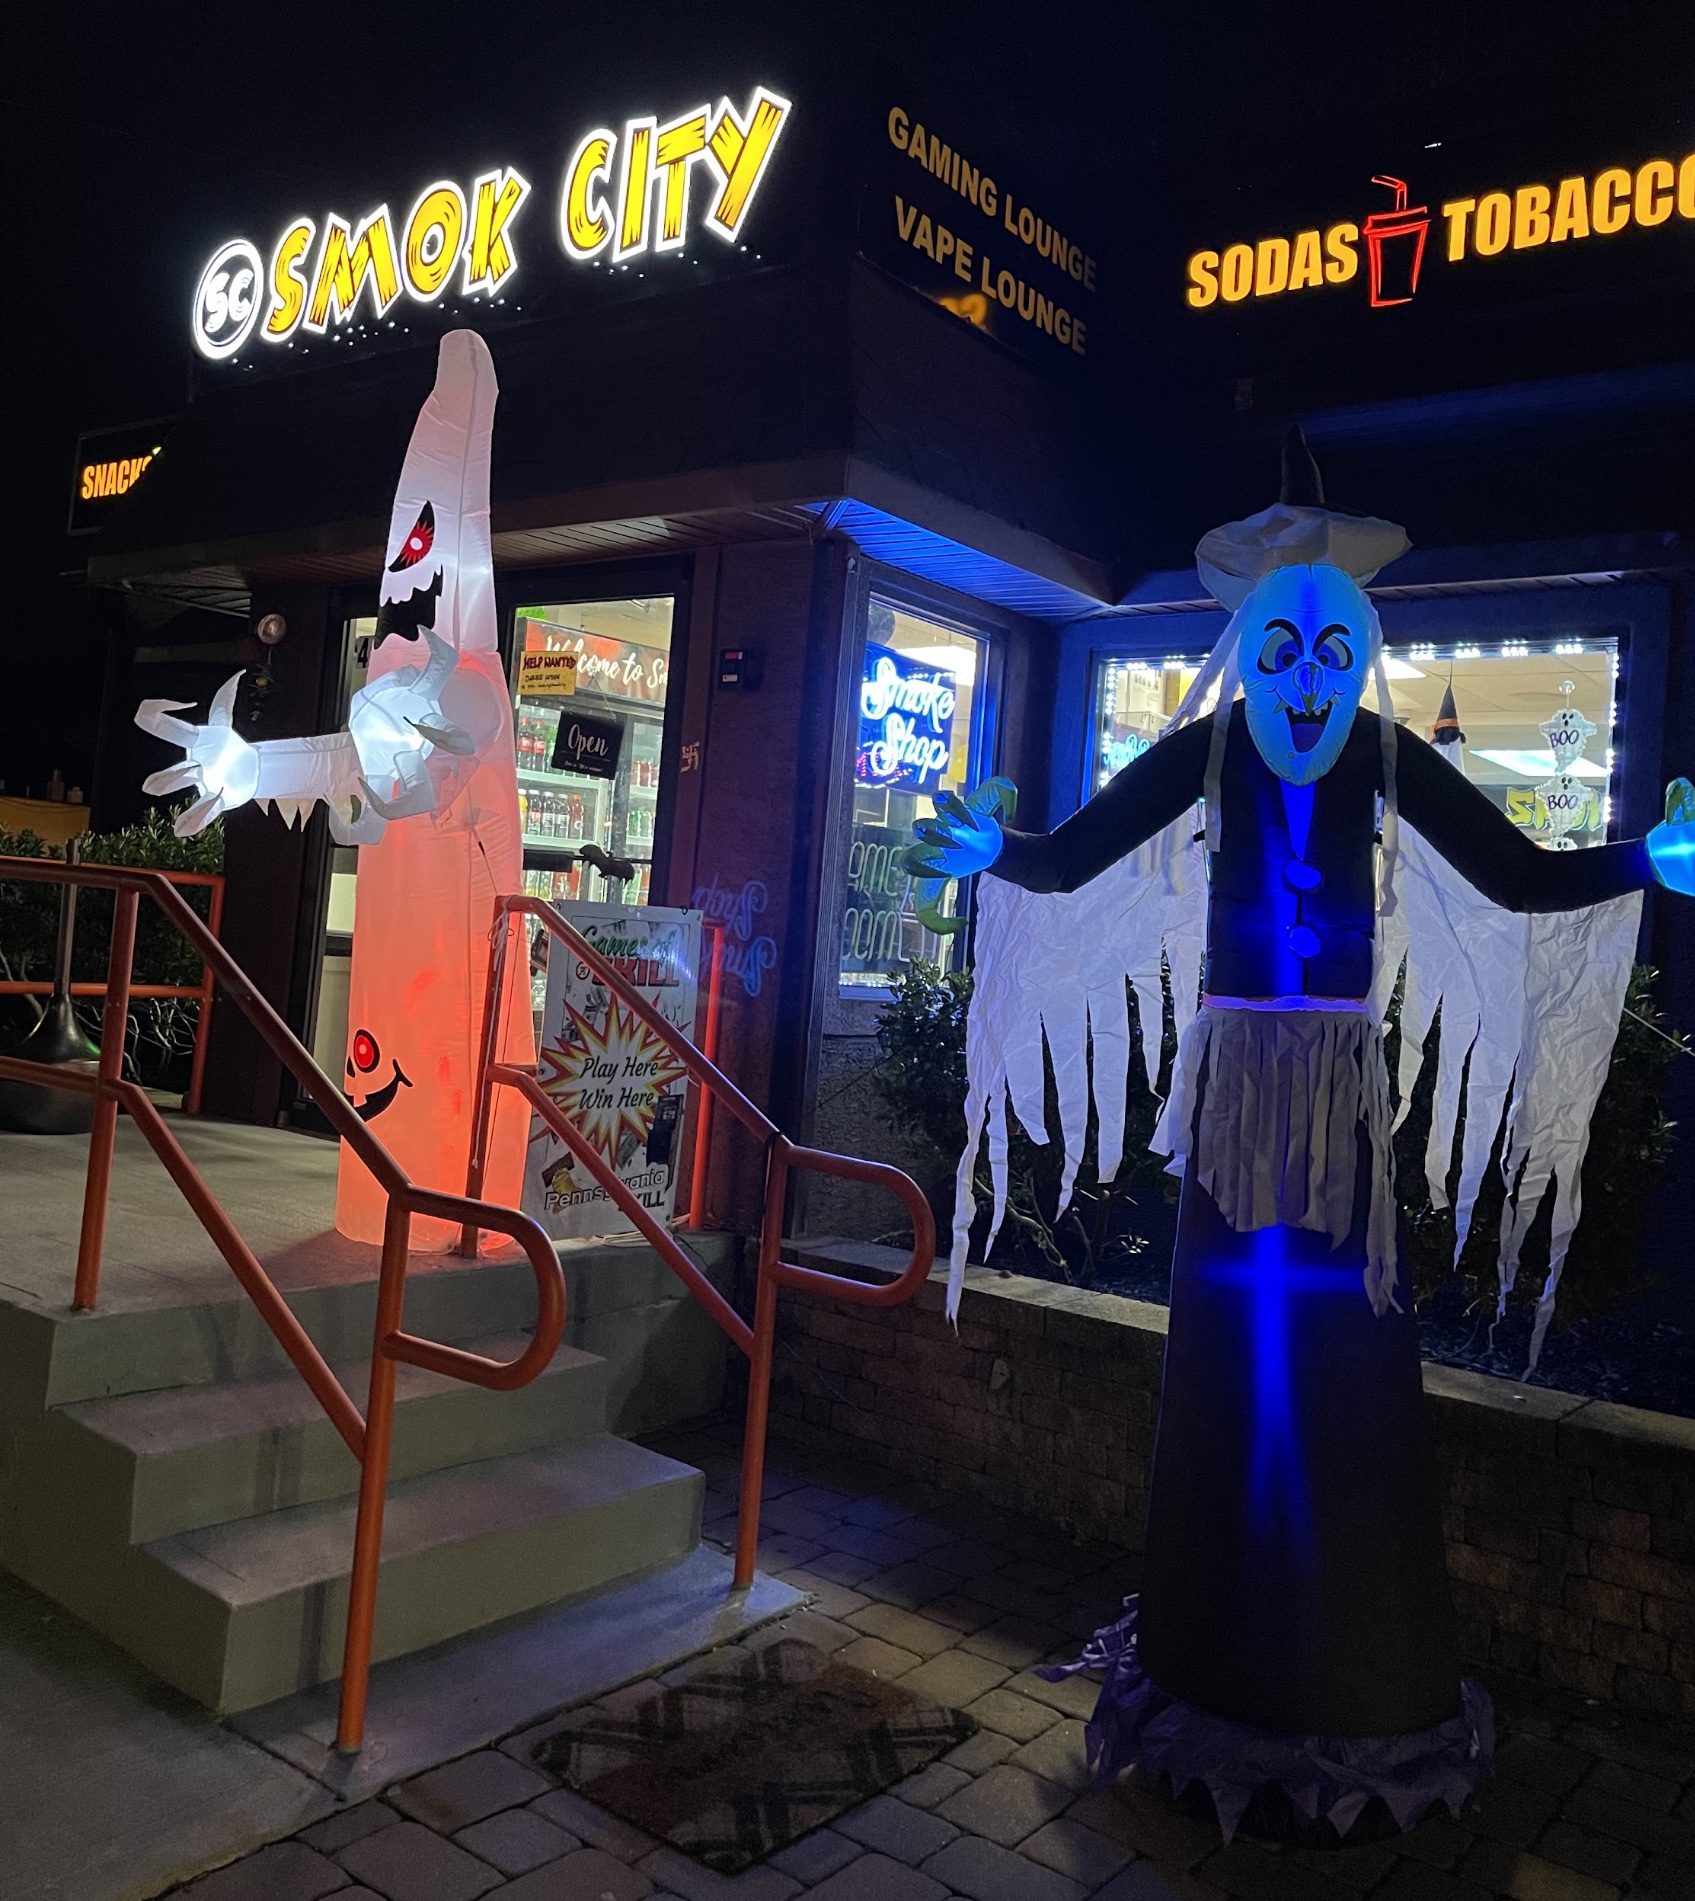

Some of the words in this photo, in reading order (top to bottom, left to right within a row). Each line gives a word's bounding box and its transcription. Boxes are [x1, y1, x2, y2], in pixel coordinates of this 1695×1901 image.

[261, 167, 531, 343] SMOK
[561, 87, 792, 259] CITY
[888, 106, 997, 217] GAMING
[1004, 193, 1096, 293] LOUNGE
[895, 194, 974, 284] VAPE
[981, 255, 1086, 356] LOUNGE
[1188, 223, 1358, 308] SODAS
[523, 655, 544, 670] HELP
[544, 655, 577, 670] WANTED
[622, 652, 644, 686] to
[860, 656, 955, 733] Smoke
[567, 723, 609, 761] Open
[870, 712, 949, 784] Shop
[1550, 729, 1580, 748] BOO
[1547, 794, 1579, 810] BOO
[580, 1055, 619, 1085] Play
[622, 1056, 659, 1077] Here
[579, 1088, 613, 1109] Win
[616, 1087, 654, 1108] Here
